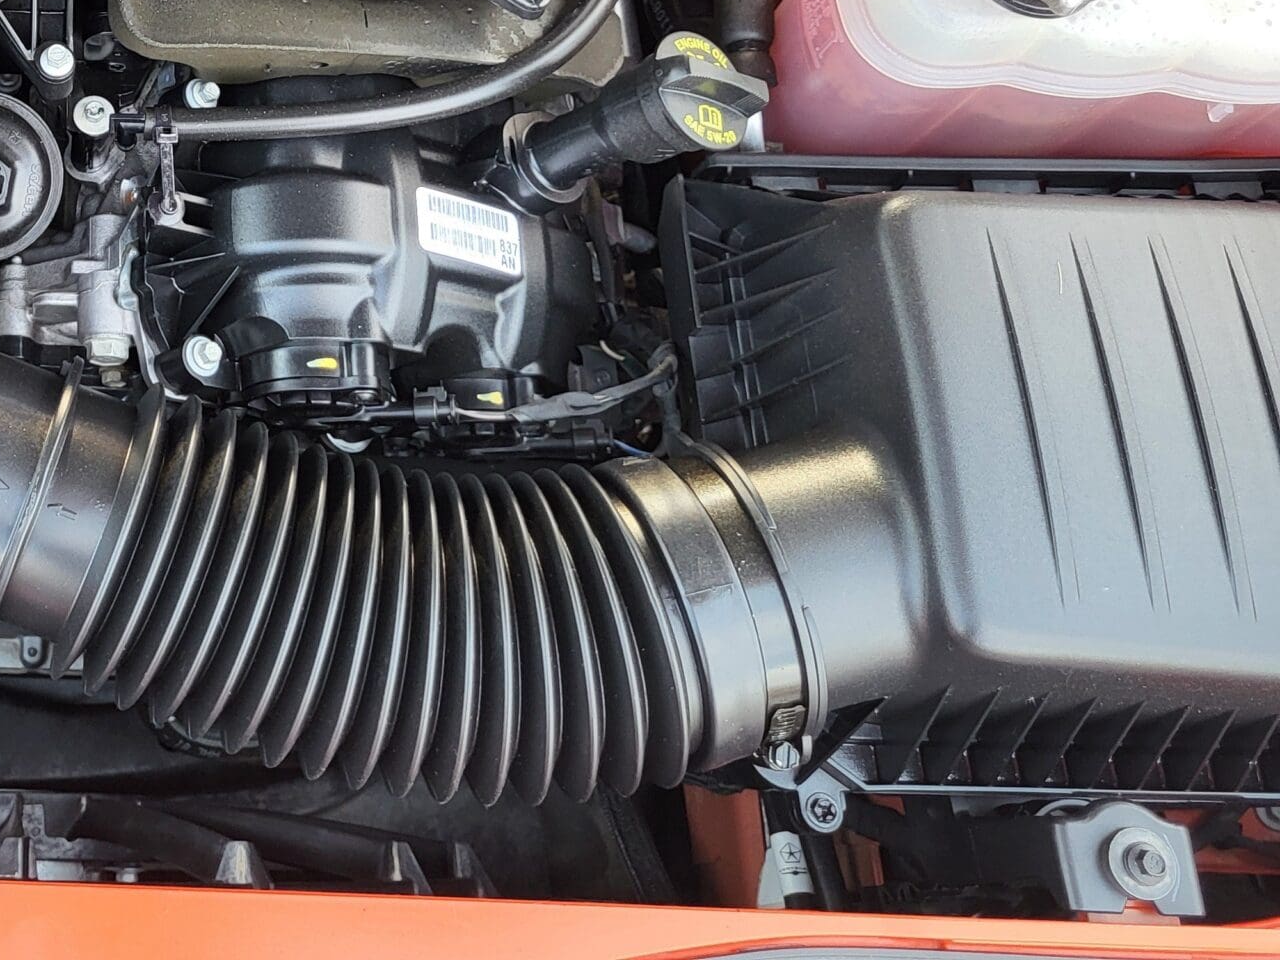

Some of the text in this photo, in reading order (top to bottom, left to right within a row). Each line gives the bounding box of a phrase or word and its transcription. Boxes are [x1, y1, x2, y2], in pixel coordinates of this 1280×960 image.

[674, 36, 728, 69] ENGINE OIL
[684, 114, 737, 145] SAE 5W-20
[499, 239, 518, 257] 837
[501, 254, 516, 270] AN
